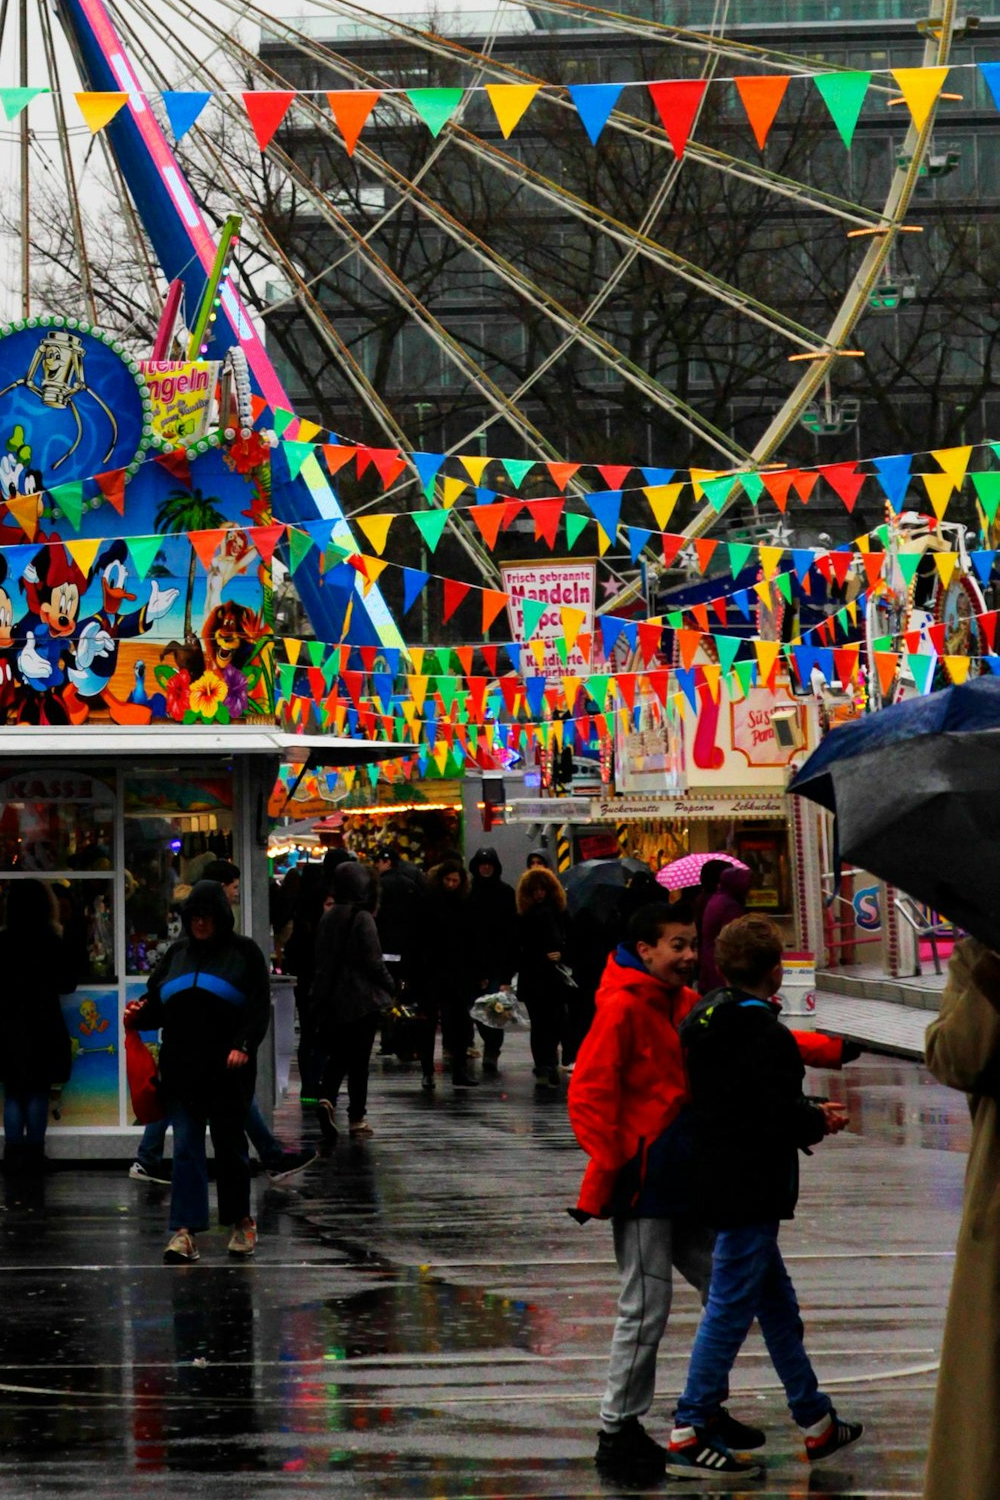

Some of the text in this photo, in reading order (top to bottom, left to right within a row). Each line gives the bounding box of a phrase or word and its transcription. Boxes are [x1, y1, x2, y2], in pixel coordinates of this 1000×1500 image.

[146, 368, 208, 405] ngeln
[507, 571, 591, 585] Frisch gebrannte
[511, 582, 591, 607] Mandeln
[526, 653, 584, 668] Kndirte
[7, 779, 93, 798] KASSE
[600, 803, 660, 816] Zuckerwatte
[674, 801, 715, 813] Popcorn
[730, 800, 782, 812] Lebkuchen
